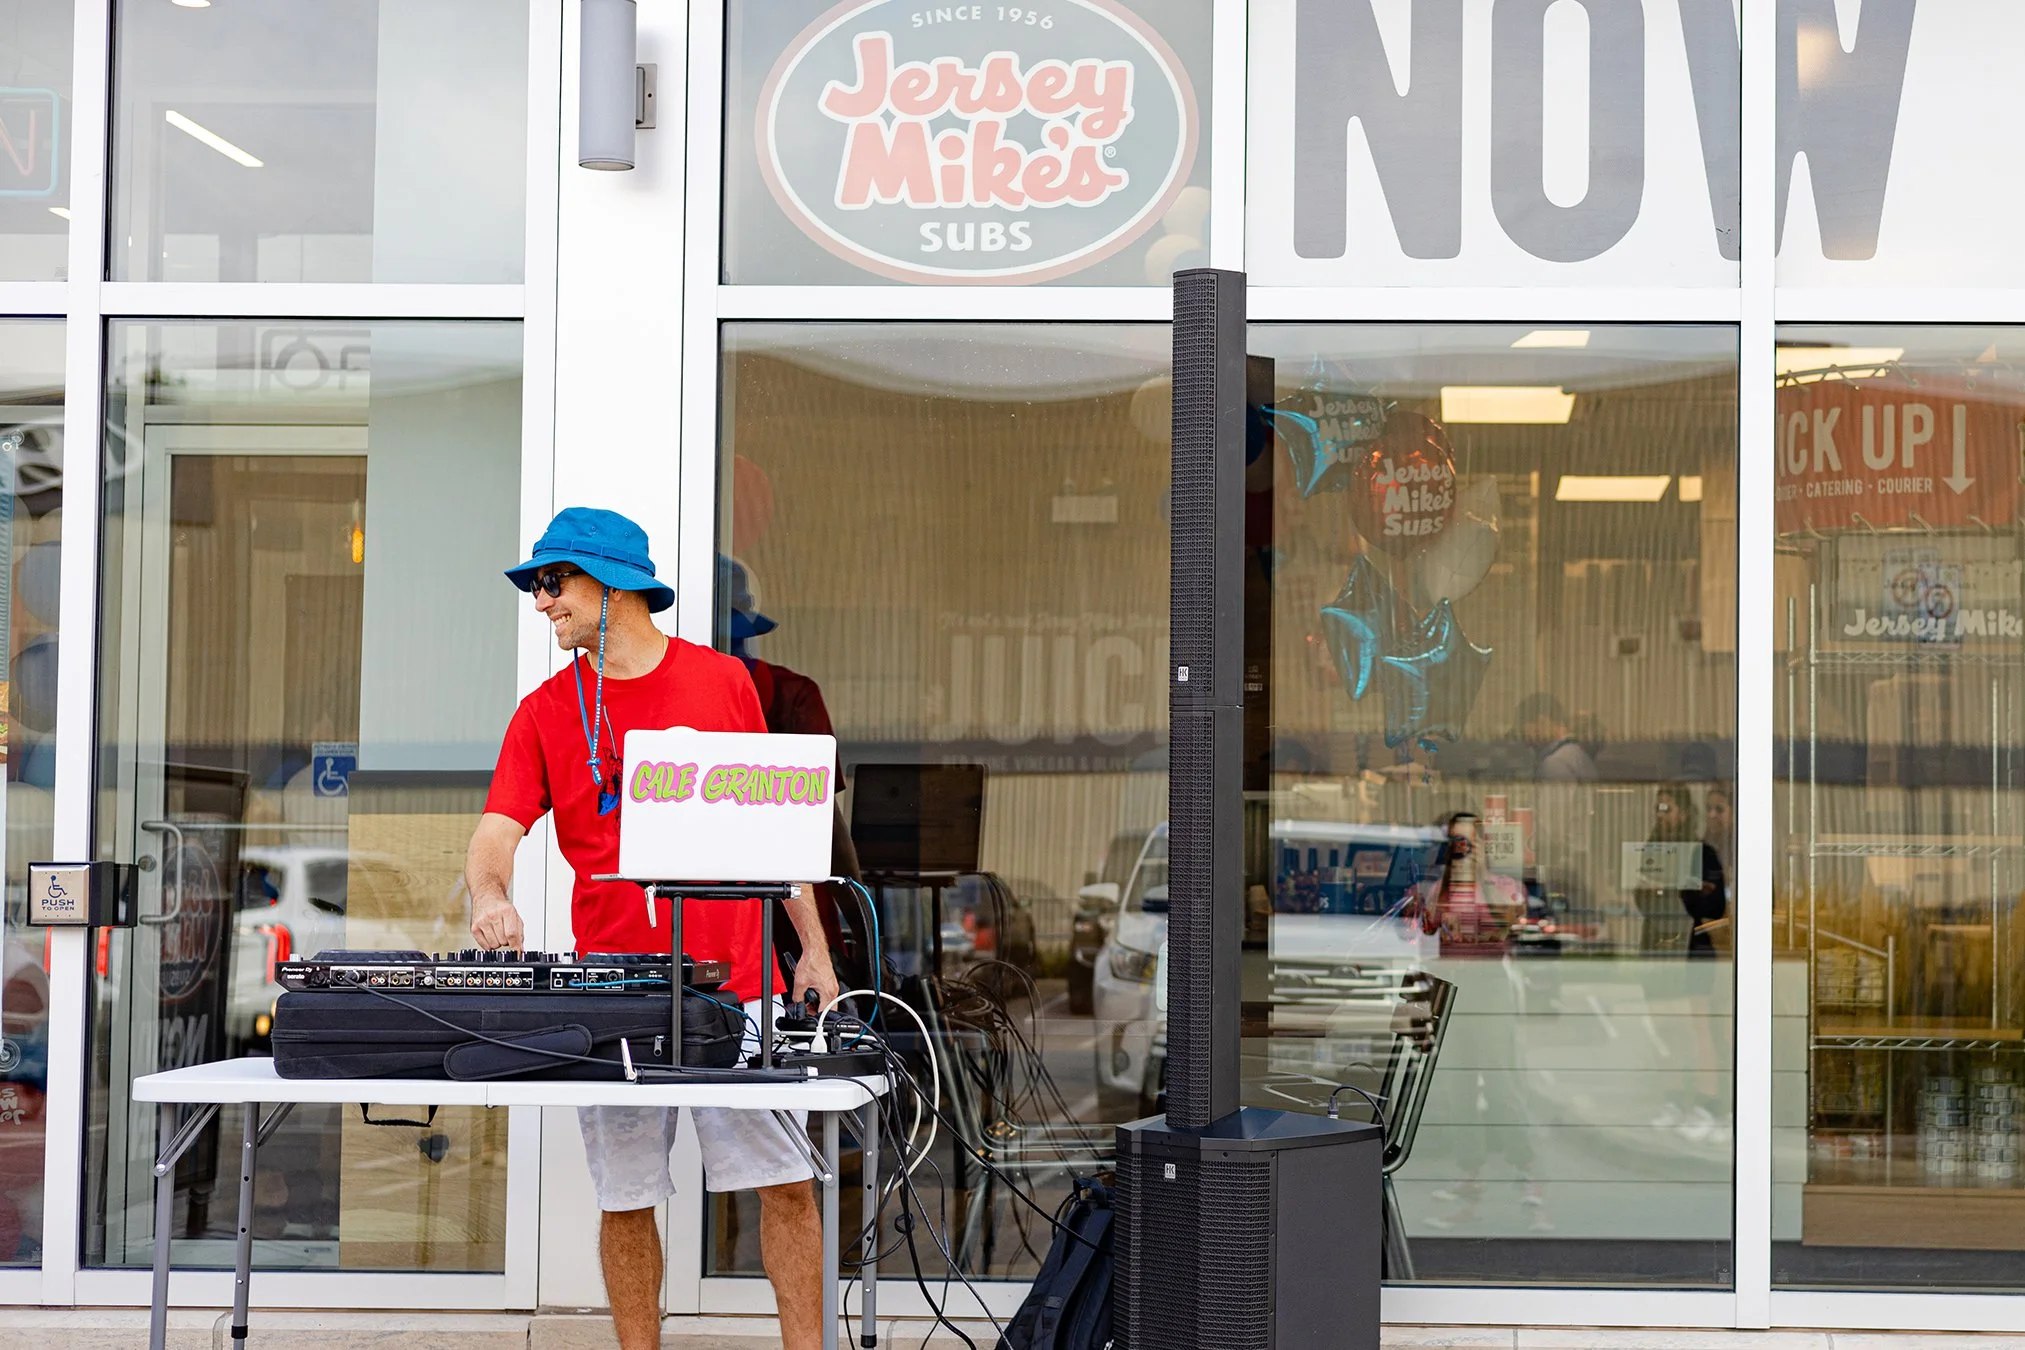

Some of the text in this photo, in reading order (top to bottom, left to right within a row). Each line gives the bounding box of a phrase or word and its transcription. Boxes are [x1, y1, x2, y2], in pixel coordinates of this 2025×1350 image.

[911, 5, 1054, 29] SINCE 1956
[822, 35, 1130, 141] Jersey
[1294, 0, 1916, 262] NOW
[837, 118, 1126, 208] Mike's
[919, 221, 1033, 252] SUBS
[1776, 404, 1934, 478] ICK UP
[1376, 458, 1451, 488] Jersey
[1806, 478, 1863, 498] CATERING
[1878, 477, 1932, 494] COURIER
[1383, 485, 1452, 513] Mike's
[1844, 608, 1945, 641] Jersey
[632, 762, 828, 804] CALE GRANTON
